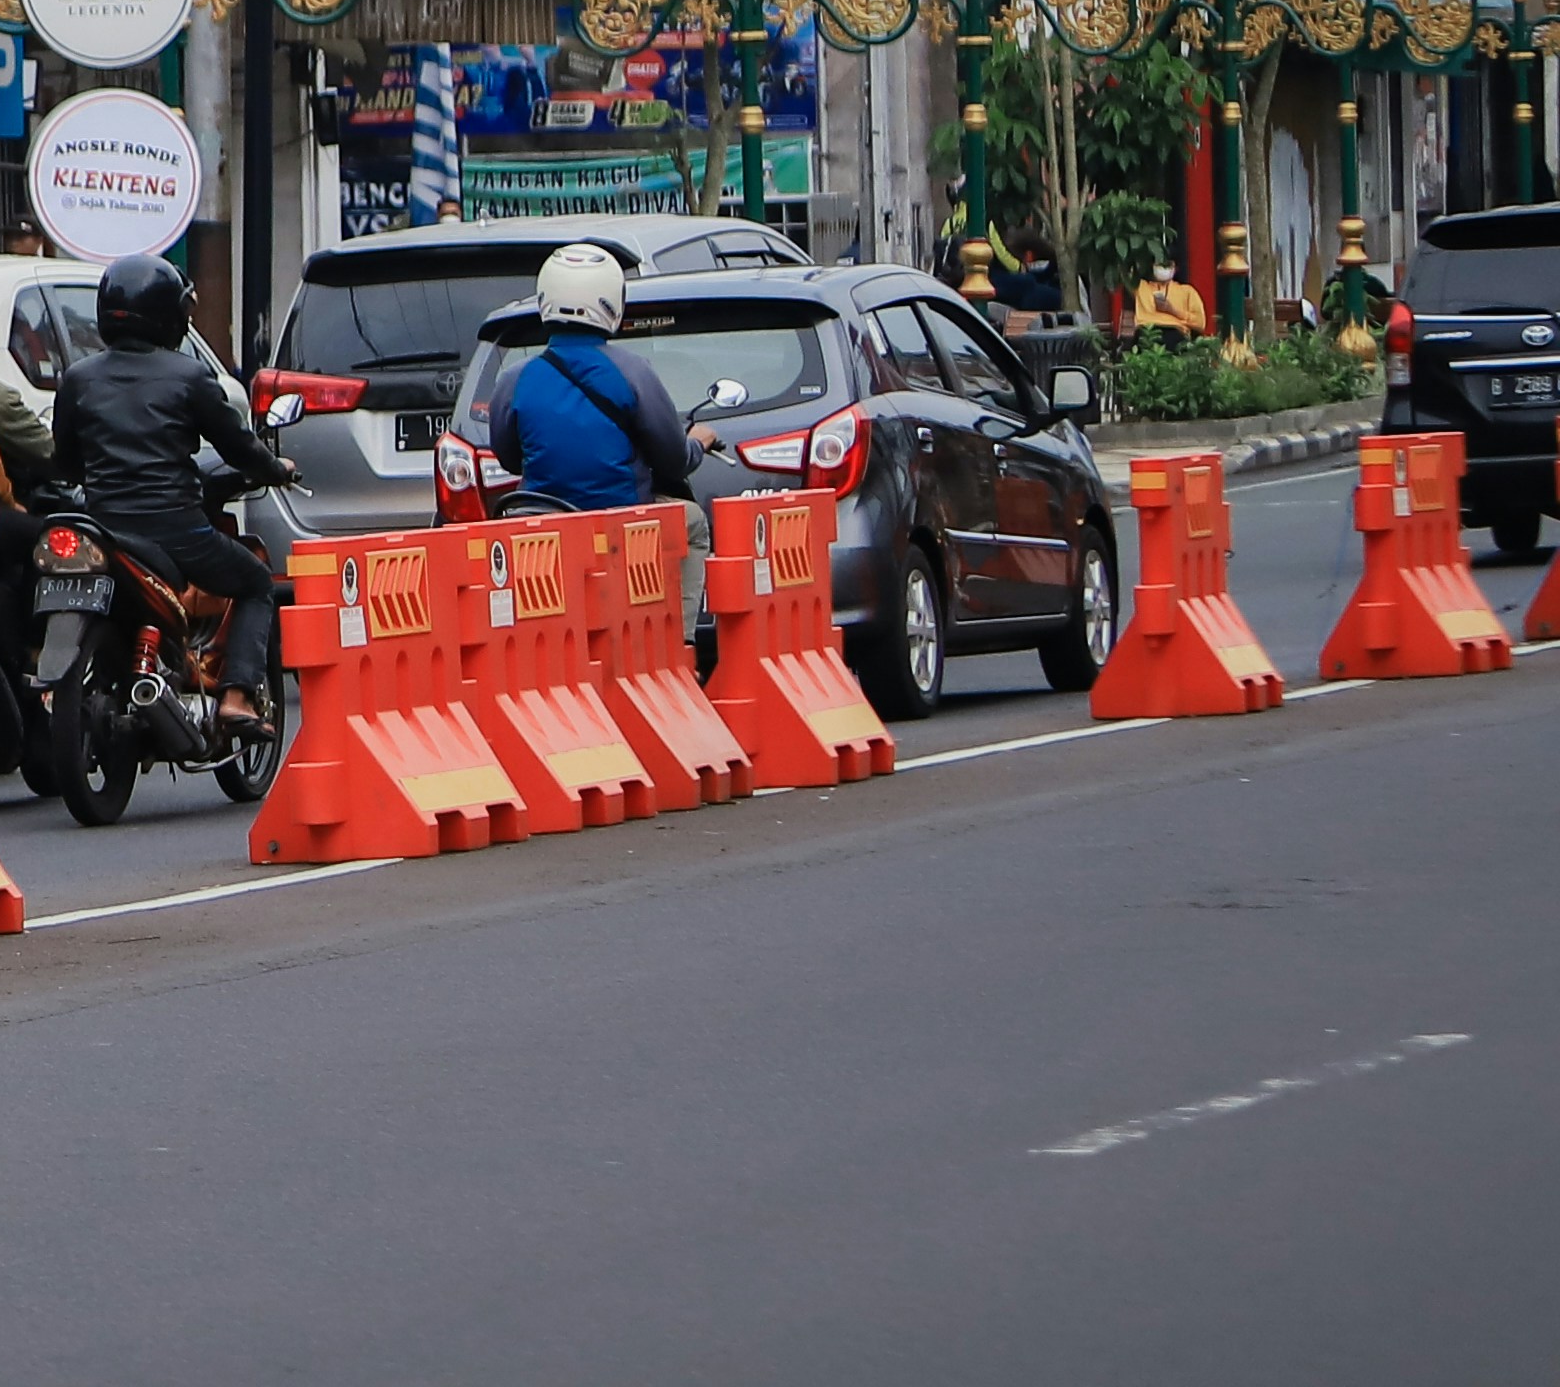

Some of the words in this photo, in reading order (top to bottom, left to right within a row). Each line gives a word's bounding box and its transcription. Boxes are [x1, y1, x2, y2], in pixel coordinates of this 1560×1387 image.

[68, 4, 146, 16] LEGENDA
[54, 140, 120, 157] ANGSLE
[123, 142, 181, 167] RONDE
[53, 167, 177, 197] KLENTENG
